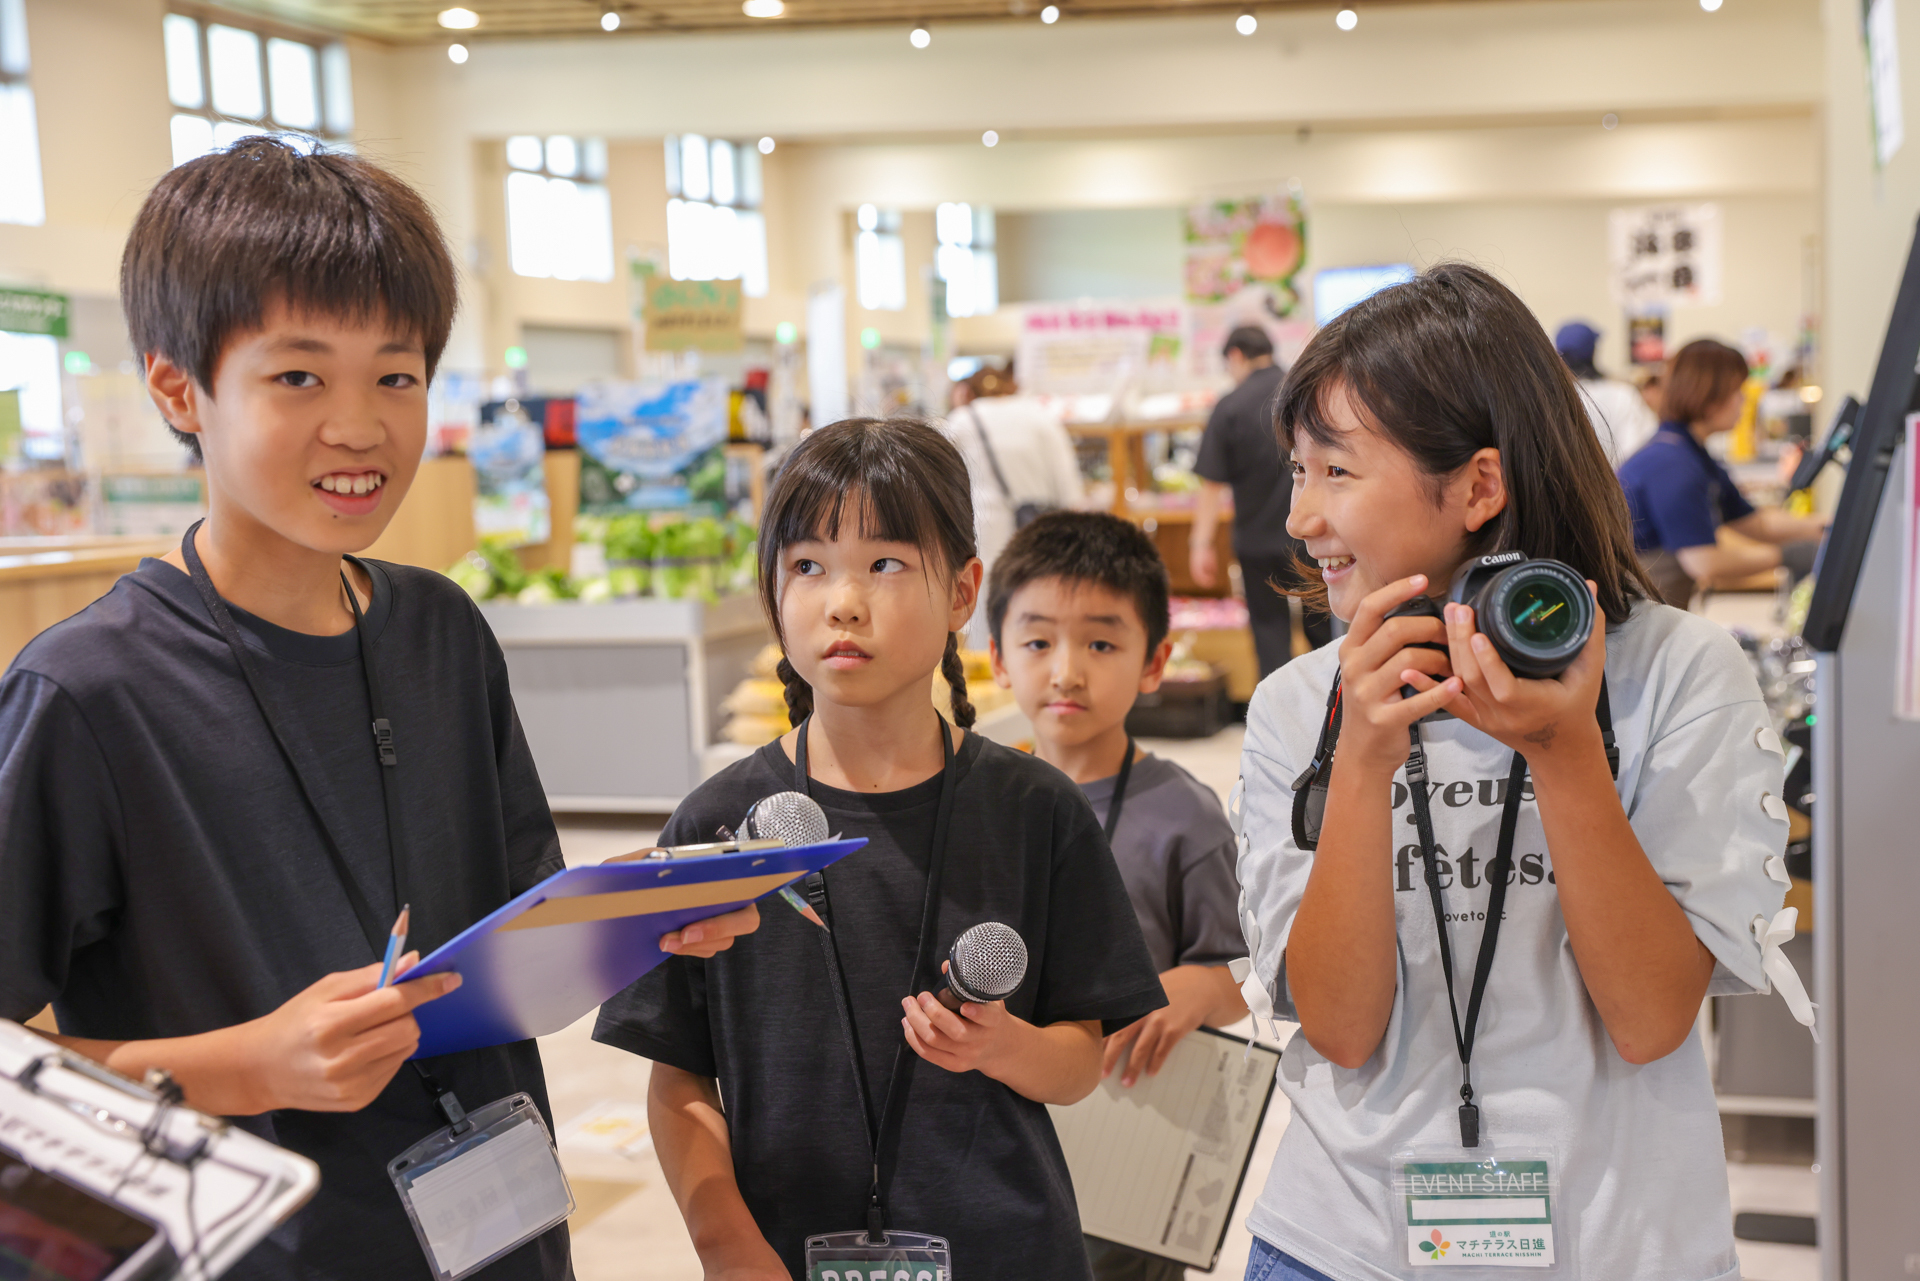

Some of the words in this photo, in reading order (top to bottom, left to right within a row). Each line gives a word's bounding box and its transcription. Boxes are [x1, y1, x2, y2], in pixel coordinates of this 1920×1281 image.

[1481, 552, 1521, 566] Canon
[1444, 910, 1507, 923] ovetoc
[1411, 1174, 1477, 1193] EVENT
[1482, 1172, 1544, 1193] STAFF
[1456, 1238, 1546, 1251] マチテラス日進
